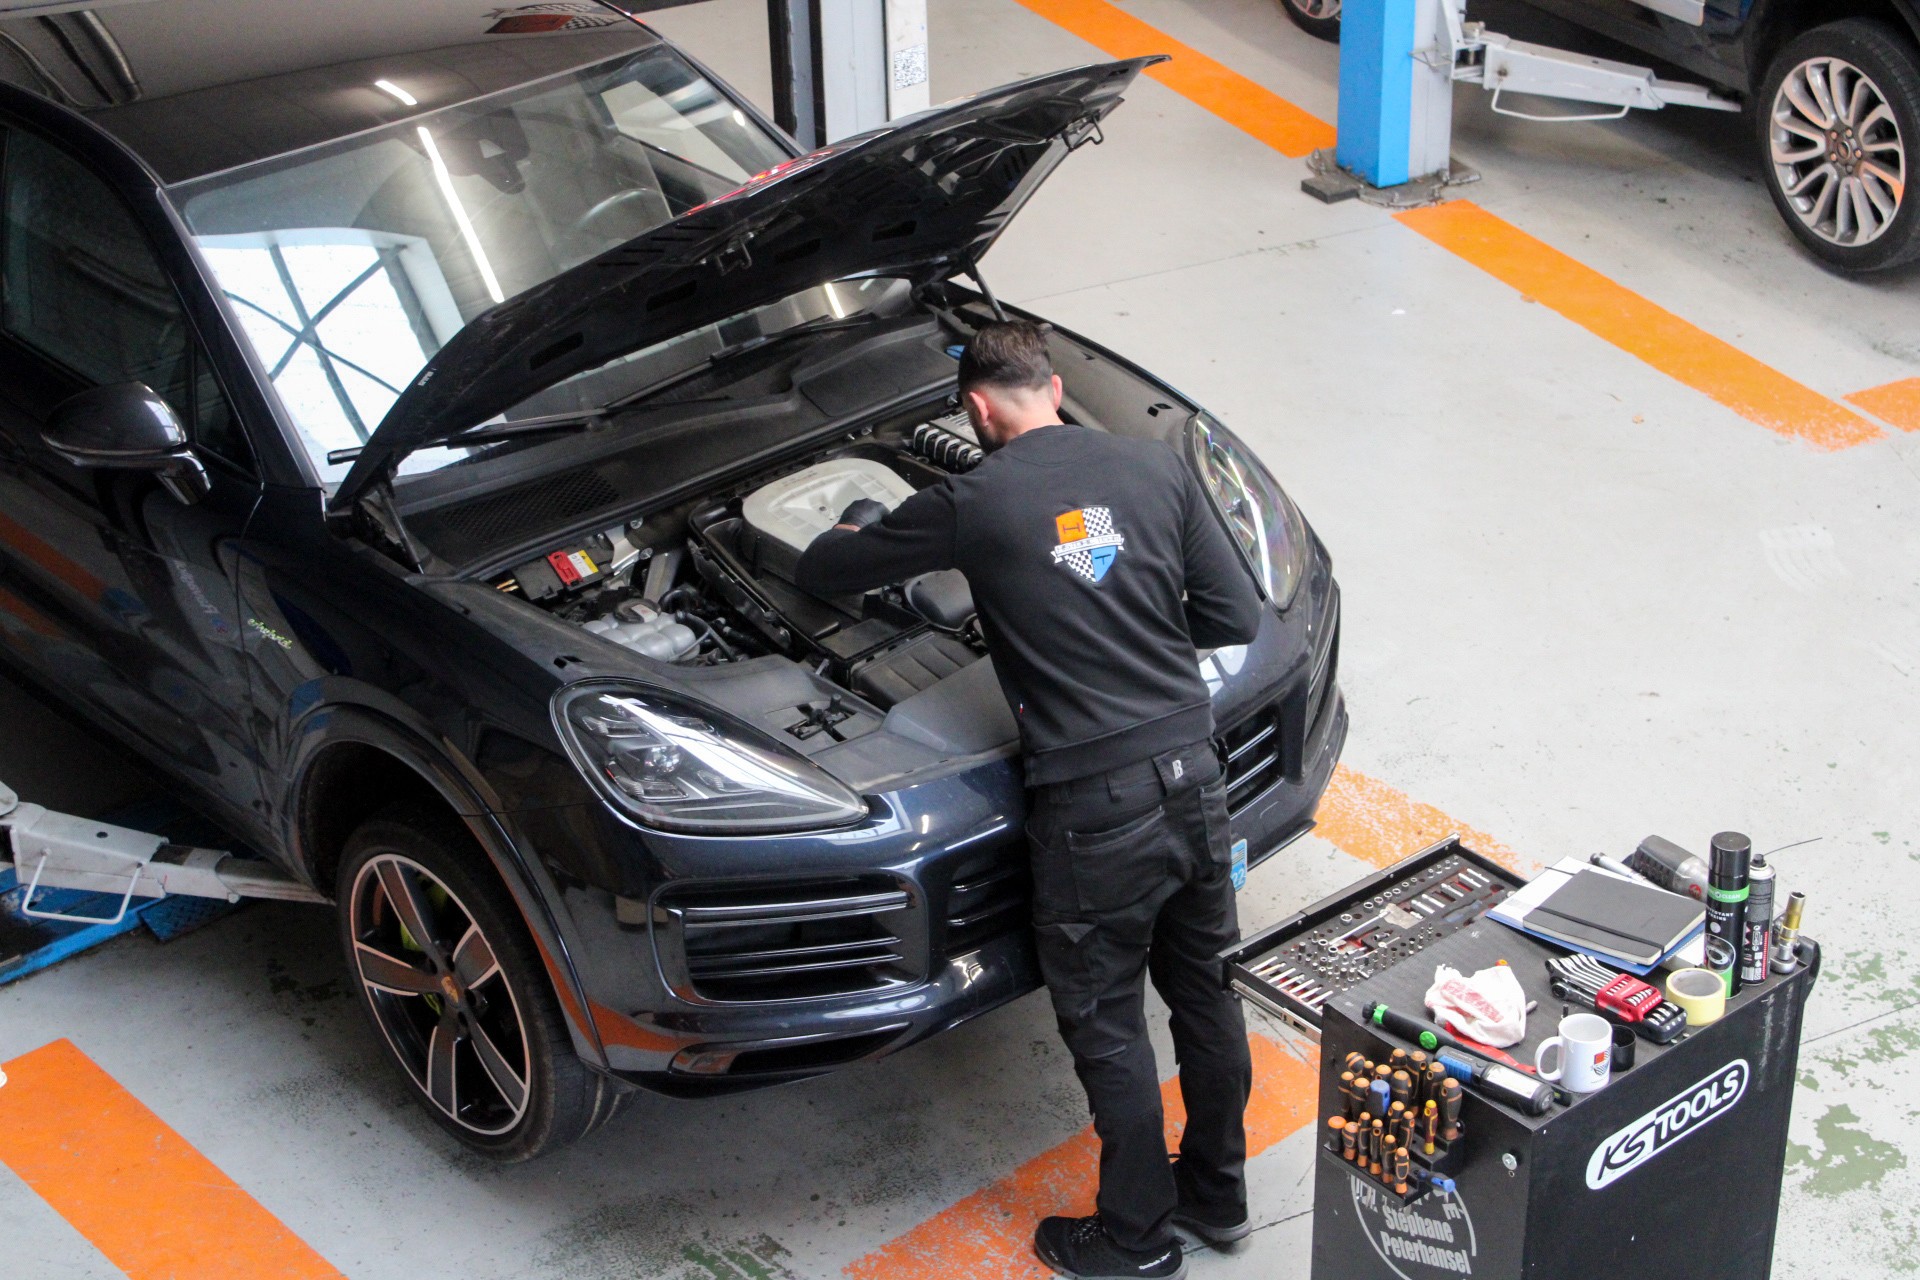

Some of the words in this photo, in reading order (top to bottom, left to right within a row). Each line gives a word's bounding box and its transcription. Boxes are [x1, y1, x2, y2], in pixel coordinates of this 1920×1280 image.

[1094, 553, 1112, 565] T
[1172, 759, 1184, 779] B
[1597, 1120, 1656, 1181] KS
[1654, 1069, 1739, 1140] TOOLS
[1379, 1230, 1472, 1275] Peterhansel
